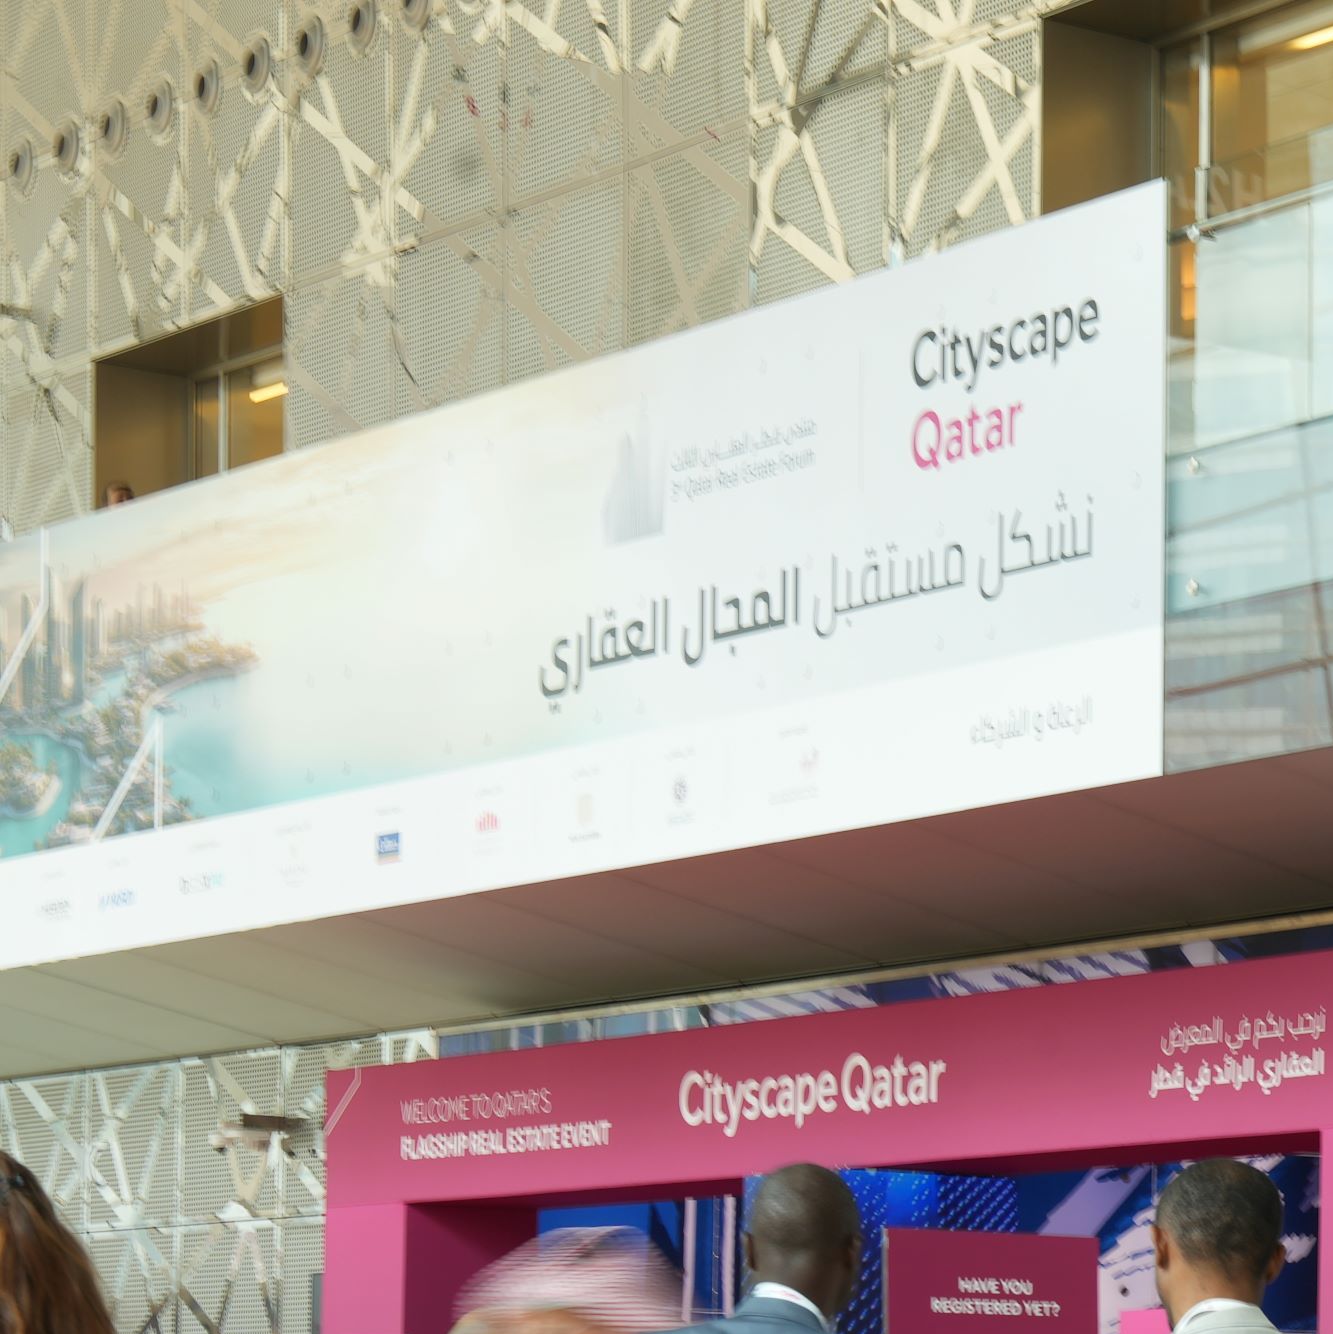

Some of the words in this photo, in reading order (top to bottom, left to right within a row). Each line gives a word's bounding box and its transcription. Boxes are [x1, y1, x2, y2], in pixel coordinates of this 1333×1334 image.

[911, 297, 1099, 392] Cityscape
[911, 402, 1024, 469] Qatar
[976, 489, 1095, 600] نشكل
[813, 541, 965, 638] مستقبل
[682, 564, 801, 666] المجال
[539, 596, 671, 714] العقاري
[1160, 1015, 1223, 1056] المعرض
[1224, 1014, 1251, 1055] في
[1252, 1010, 1285, 1049] بكم
[1148, 1061, 1185, 1098] قطر
[1184, 1058, 1212, 1101] في
[1256, 1047, 1326, 1095] العقاري
[400, 1095, 471, 1124] WELCOME
[471, 1092, 493, 1119] TO
[679, 1068, 839, 1138] Cityscape
[841, 1051, 947, 1115] Qatar
[400, 1131, 469, 1161] FLAGSHIP
[468, 1127, 507, 1156] REAL
[506, 1122, 561, 1153] ESTATE
[560, 1118, 613, 1149] EVENT
[930, 1296, 1022, 1316] REGISTERED
[1023, 1300, 1061, 1317] YET?
[957, 1276, 1000, 1294] HAVE
[1000, 1278, 1034, 1296] YOU
